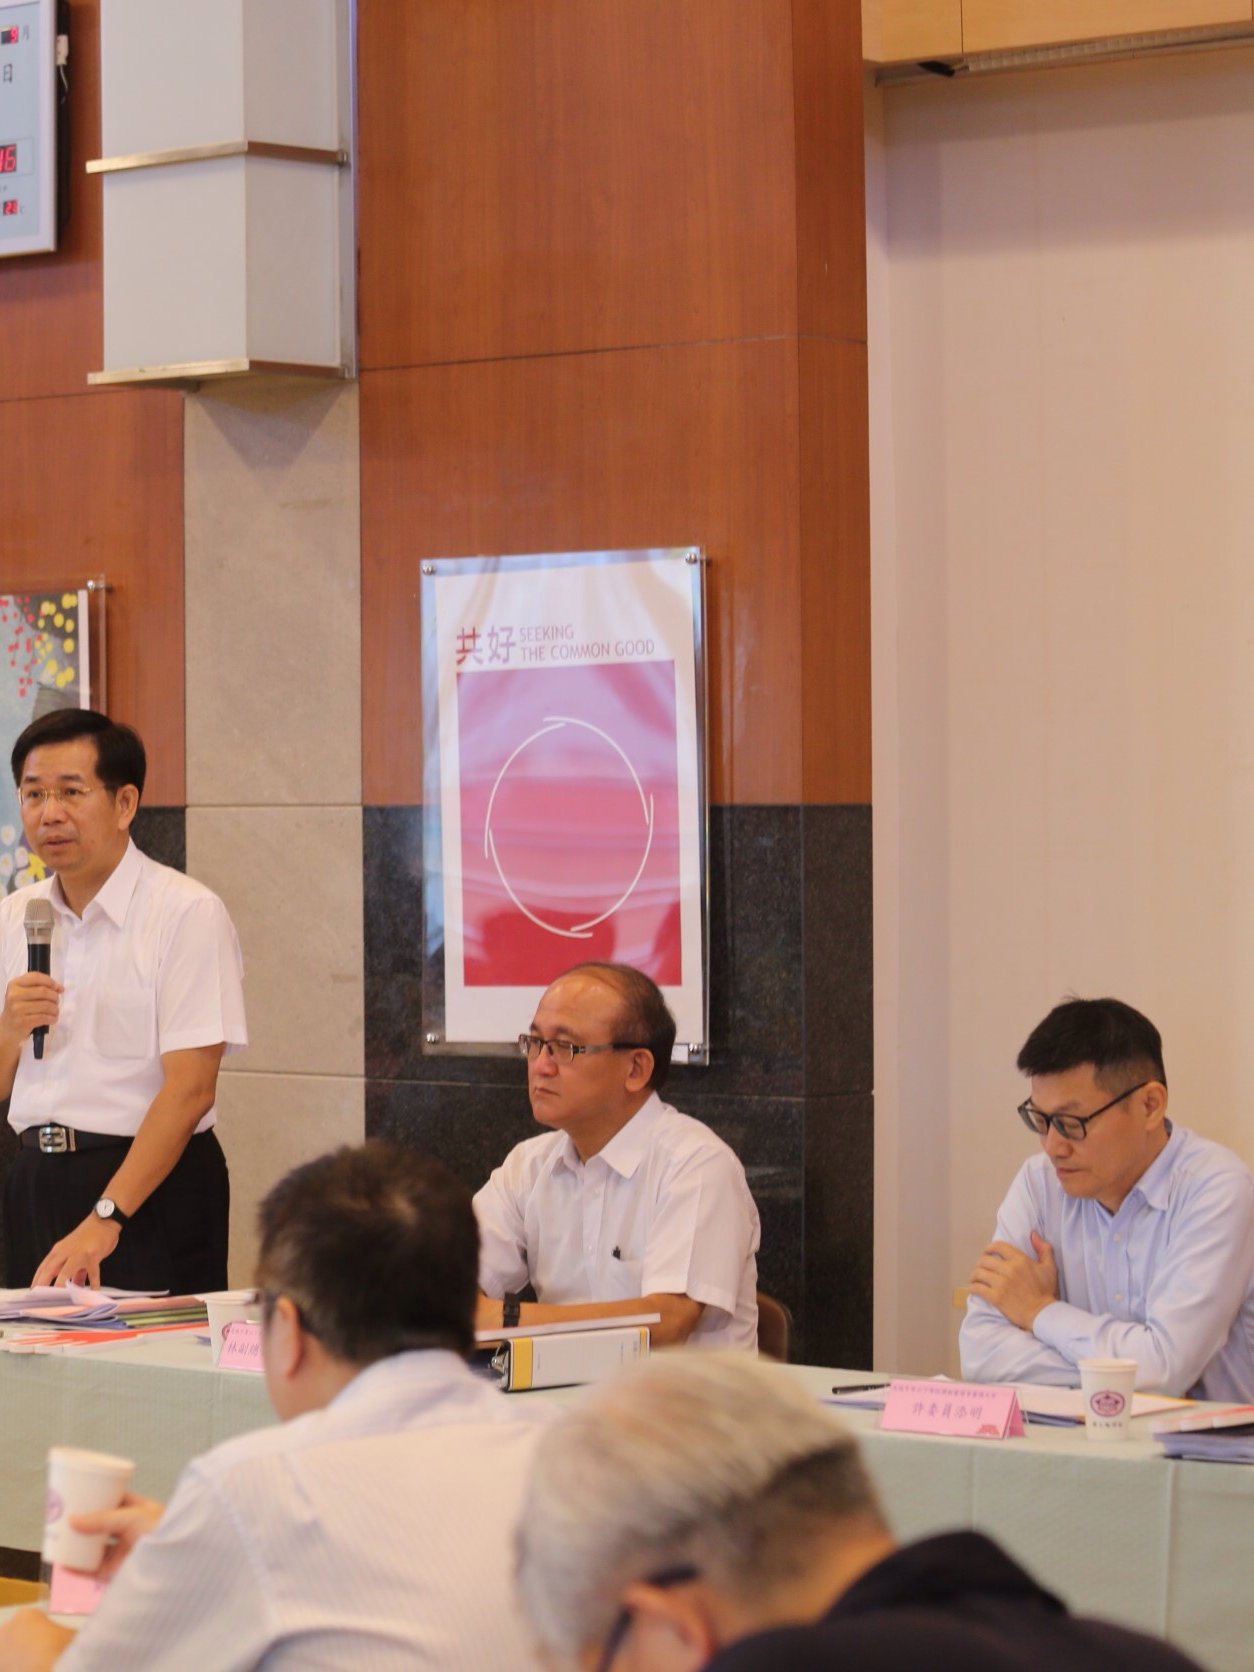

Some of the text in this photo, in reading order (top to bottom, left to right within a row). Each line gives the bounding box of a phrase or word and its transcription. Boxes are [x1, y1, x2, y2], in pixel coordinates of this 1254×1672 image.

[4, 63, 13, 83] 日
[520, 624, 574, 642] SEEKING
[456, 625, 516, 665] 共好
[521, 639, 655, 662] THE COMMON GOOD
[228, 1340, 260, 1356] 林副總
